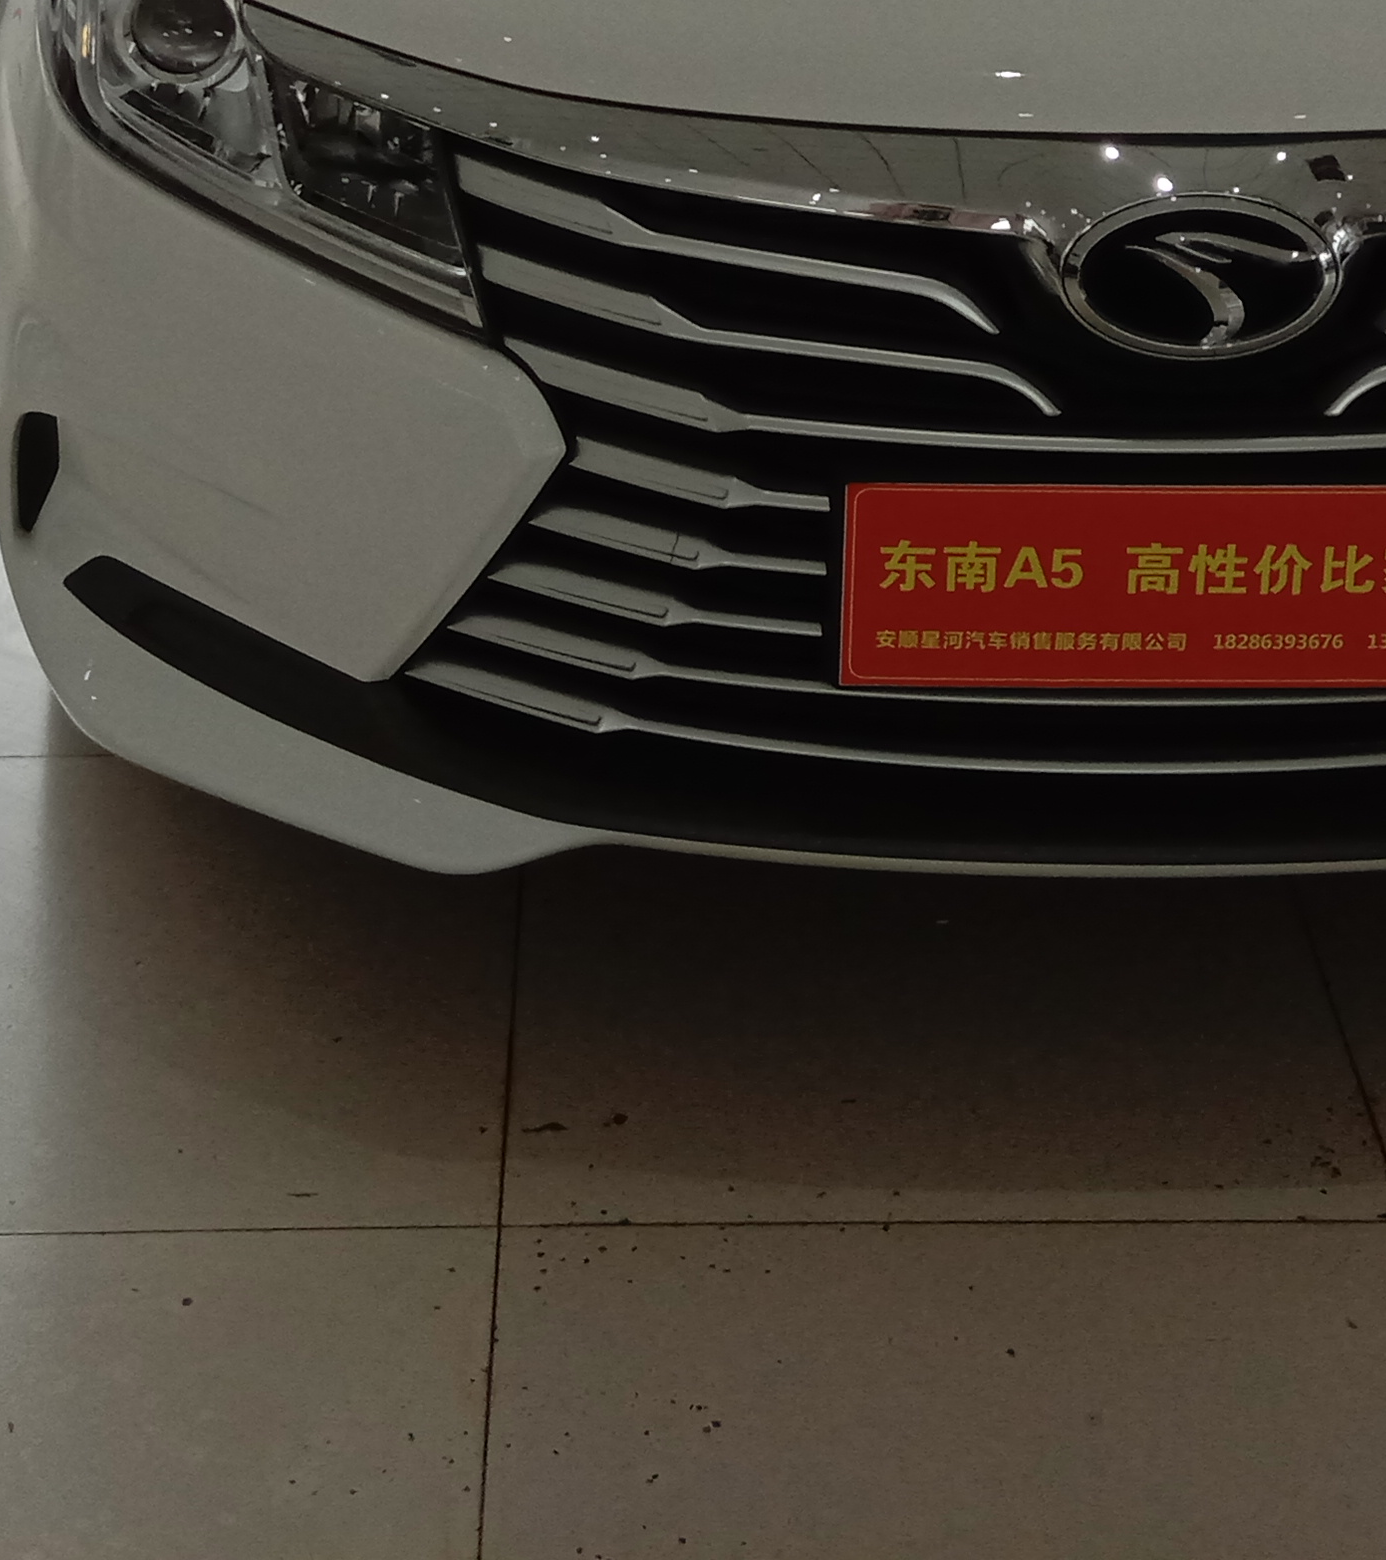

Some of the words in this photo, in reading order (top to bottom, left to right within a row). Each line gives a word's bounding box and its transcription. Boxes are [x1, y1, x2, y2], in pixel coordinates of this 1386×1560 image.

[879, 540, 1084, 592] 东南A5
[875, 629, 1187, 652] 安顺星河汽车销售服务有限公司
[1212, 633, 1344, 650] 18286393676
